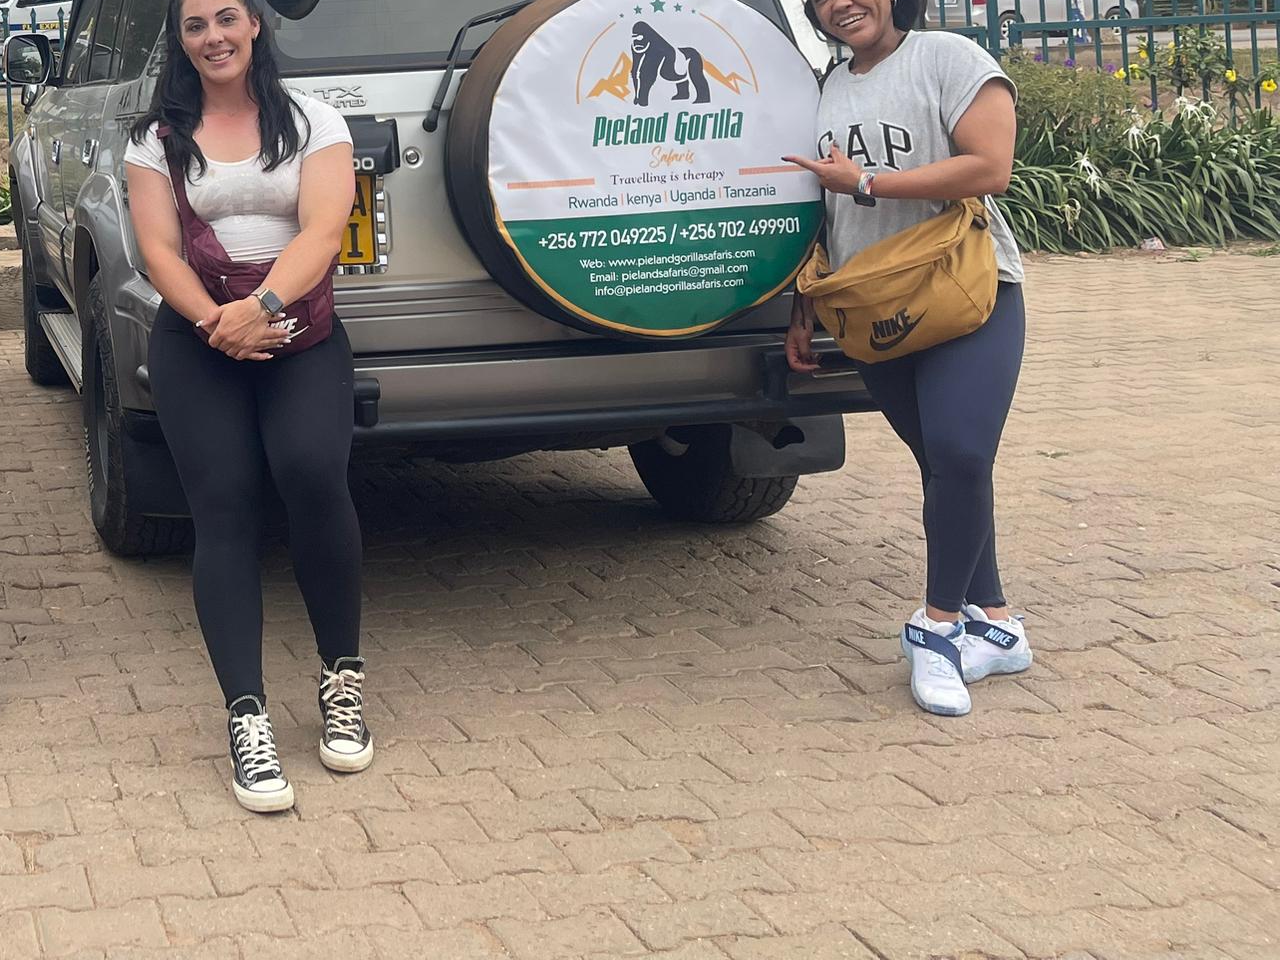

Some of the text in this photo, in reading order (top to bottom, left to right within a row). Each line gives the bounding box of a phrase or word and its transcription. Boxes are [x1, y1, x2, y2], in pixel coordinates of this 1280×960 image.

[592, 108, 743, 147] Pieland Gorilla
[649, 145, 696, 168] Safaris
[610, 169, 725, 185] Travelling is therapy
[569, 184, 776, 209] Rwanda kenya Uganda Tanzania
[538, 216, 800, 250] +256 772 049225 / +256 702 499901
[579, 249, 756, 269] Web: www.pielandgorillasafaris.com
[590, 264, 749, 283] Email: pielandsafaris@gmail.com
[595, 277, 744, 297] info@pielandgorillasafaris.com
[871, 306, 913, 340] NIKE
[908, 627, 926, 645] NIKE
[984, 627, 1013, 646] NIKE
